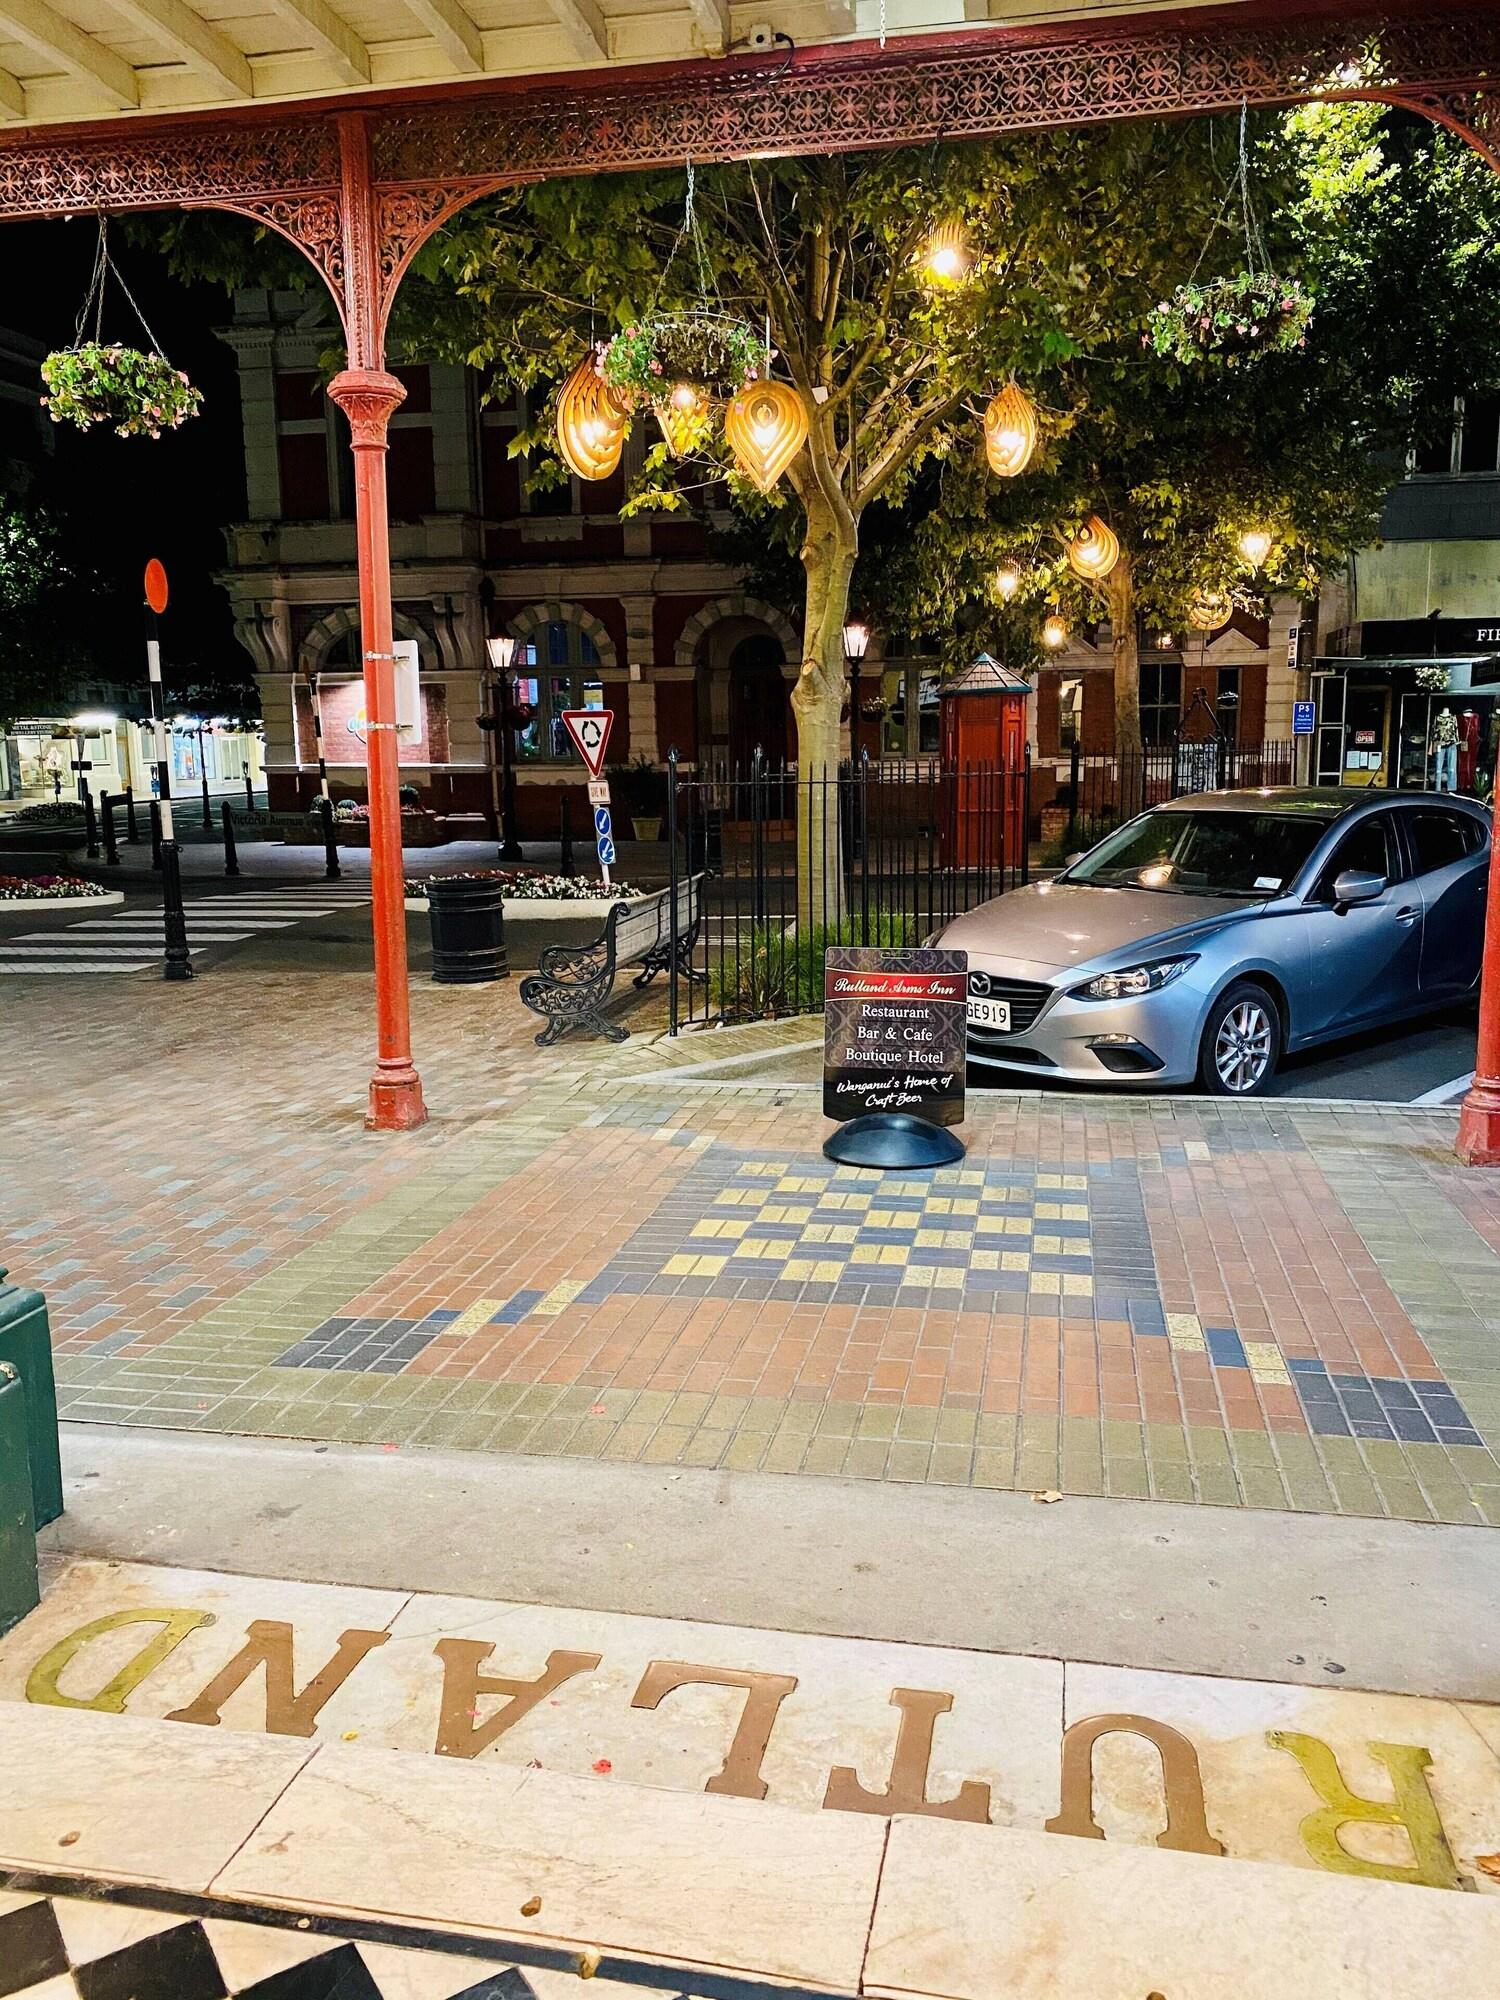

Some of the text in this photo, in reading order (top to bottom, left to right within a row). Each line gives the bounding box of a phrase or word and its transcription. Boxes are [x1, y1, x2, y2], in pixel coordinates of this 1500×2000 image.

[888, 979, 925, 994] Arms
[927, 980, 957, 995] Inn
[861, 1004, 930, 1019] Restaurant
[967, 1001, 1007, 1024] GE919
[857, 1026, 933, 1041] Bar & Cafe
[845, 1047, 943, 1064] Boutique Hotel
[836, 1074, 954, 1094] Wanganui's Home of
[865, 1092, 922, 1108] Craft Beer
[25, 1607, 1478, 1893] RUTLAND
